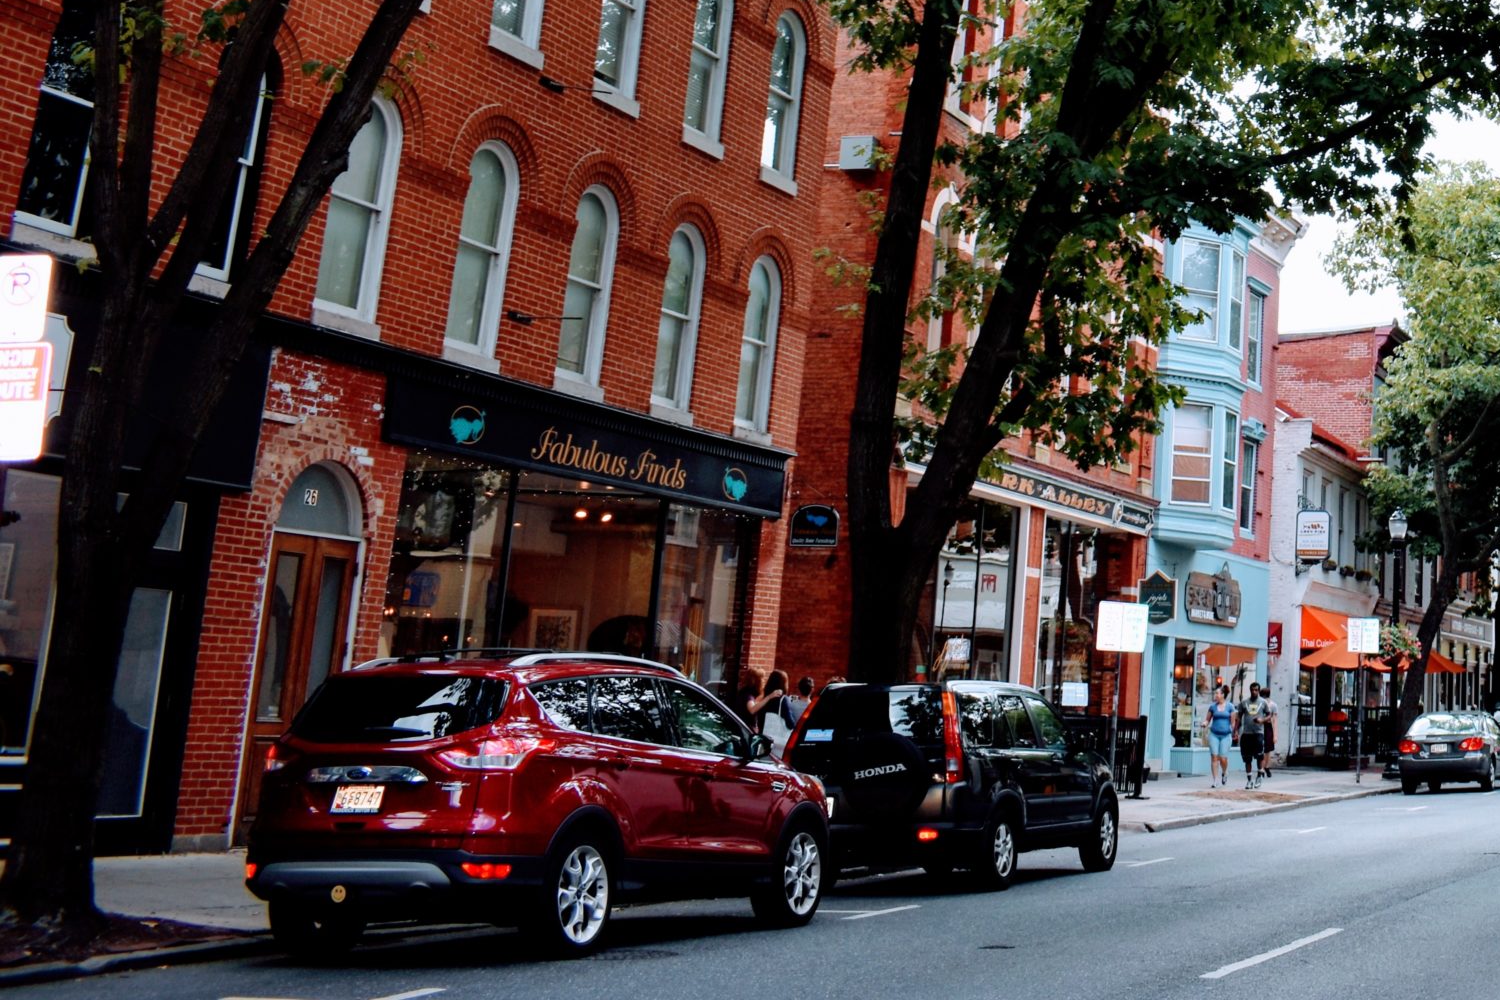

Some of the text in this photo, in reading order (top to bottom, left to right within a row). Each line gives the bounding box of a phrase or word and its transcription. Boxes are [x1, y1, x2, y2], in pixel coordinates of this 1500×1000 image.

[0, 349, 37, 367] NOW
[0, 382, 36, 399] UTE
[531, 426, 687, 490] Fabulous Finds
[304, 490, 317, 505] 26
[854, 763, 907, 780] HONDA
